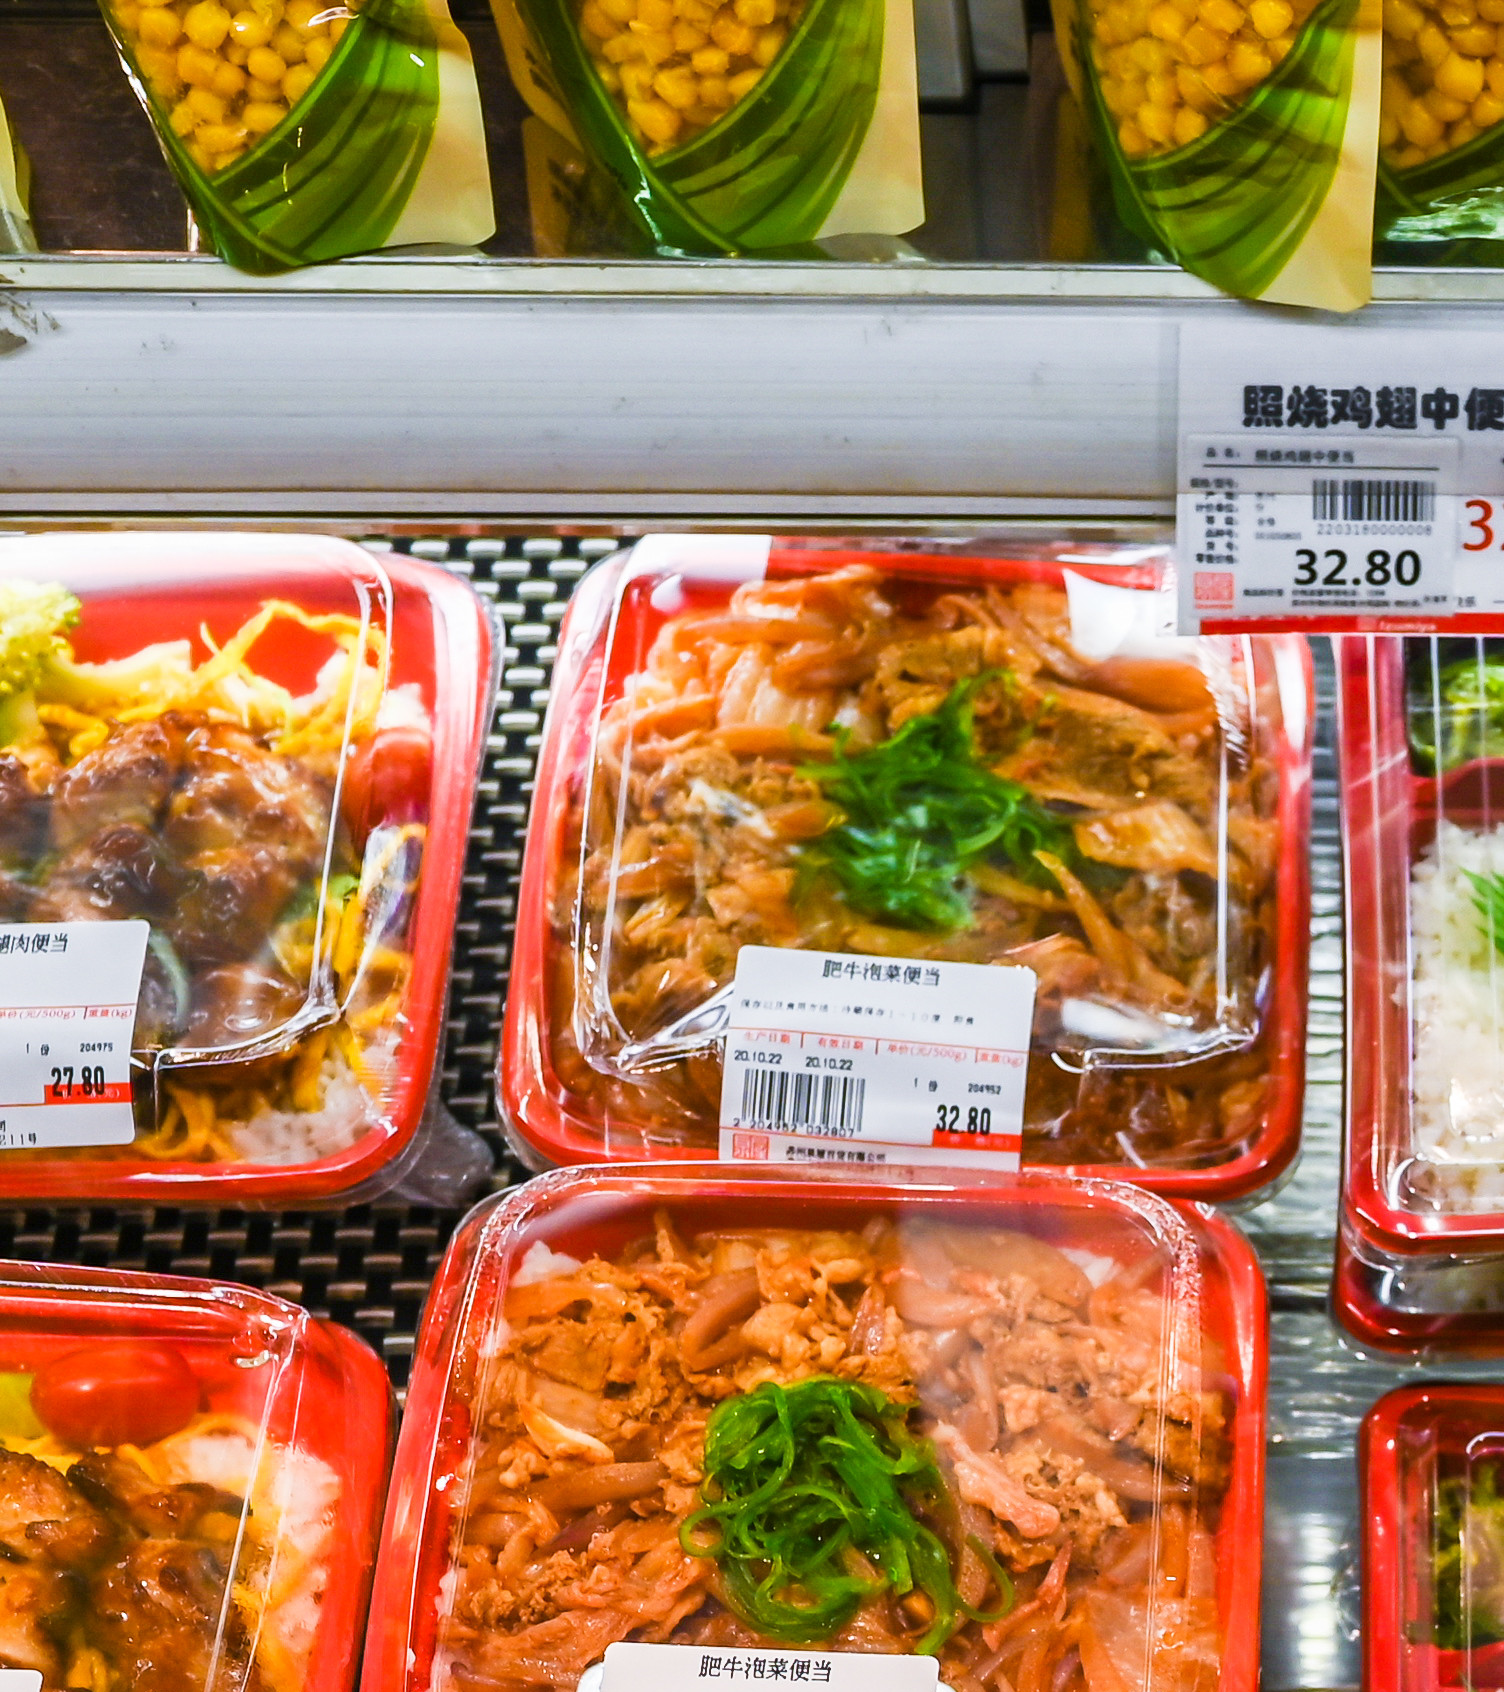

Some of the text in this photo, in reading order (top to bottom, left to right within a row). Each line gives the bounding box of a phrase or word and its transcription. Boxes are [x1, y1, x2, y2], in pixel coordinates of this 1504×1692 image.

[1293, 549, 1421, 586] 32.80
[822, 959, 941, 987] 肥牛泡菜便当
[734, 1050, 853, 1071] 20.10.22 20.10.22
[51, 1065, 105, 1098] 27.80
[936, 1104, 991, 1135] 32.80
[698, 1655, 832, 1683] 肥牛泡菜便当
